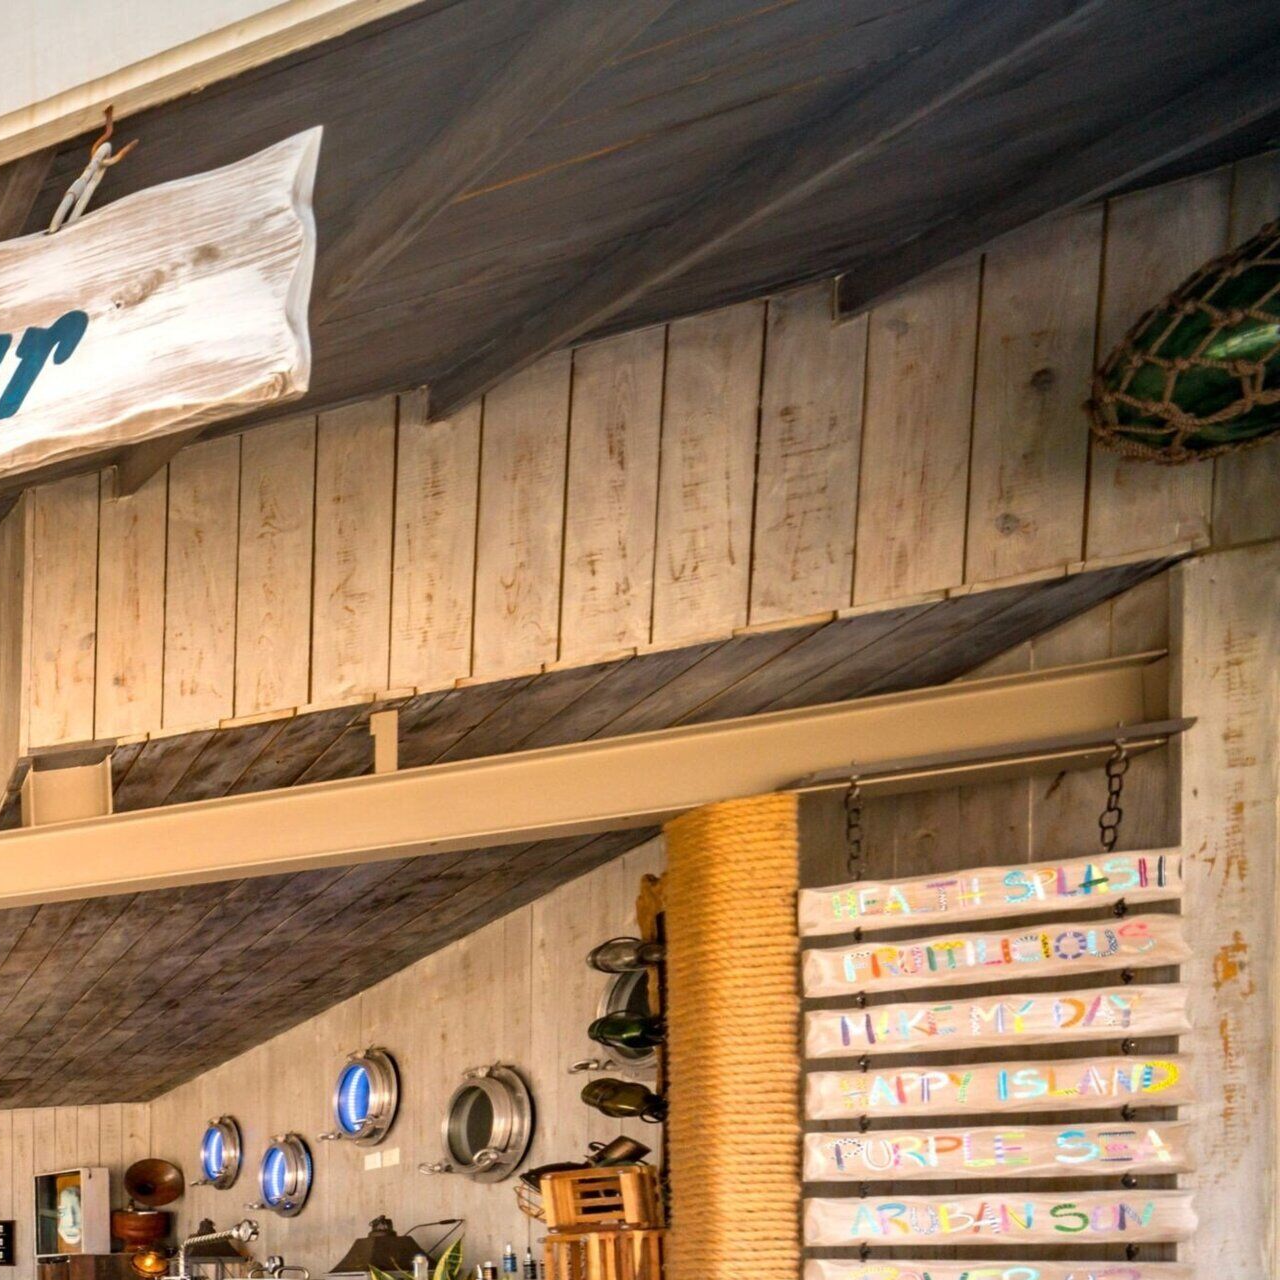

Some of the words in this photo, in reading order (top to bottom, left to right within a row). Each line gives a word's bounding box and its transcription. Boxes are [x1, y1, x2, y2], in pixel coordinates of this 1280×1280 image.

[1002, 855, 1167, 904] SPLASH
[970, 999, 1035, 1037] MY
[1053, 994, 1137, 1029] DAY
[840, 1071, 973, 1109] HAPPY
[997, 1060, 1180, 1101] ISLAND
[826, 1132, 1032, 1171] PURPLE
[1055, 1129, 1173, 1165] SEA
[850, 1202, 1034, 1236] ARUBAN
[1049, 1202, 1156, 1234] SUN
